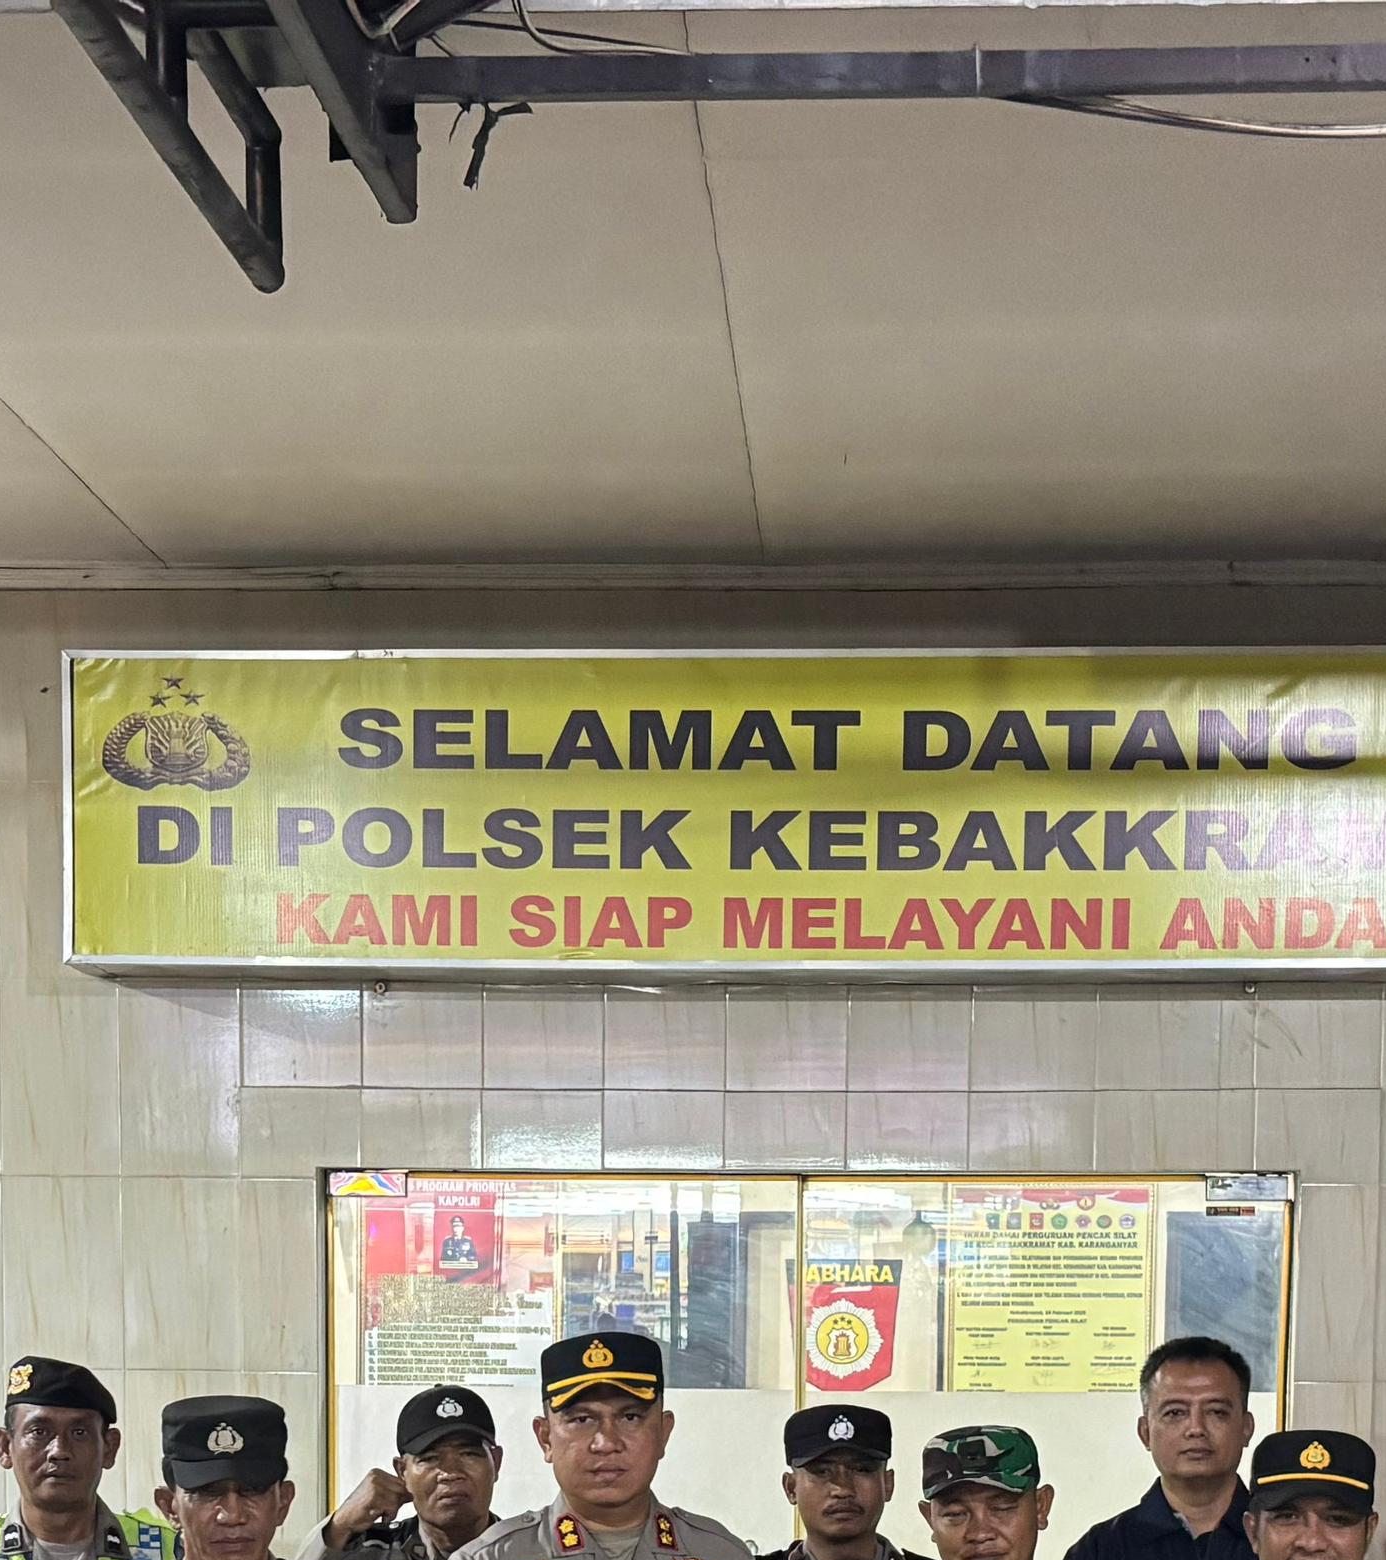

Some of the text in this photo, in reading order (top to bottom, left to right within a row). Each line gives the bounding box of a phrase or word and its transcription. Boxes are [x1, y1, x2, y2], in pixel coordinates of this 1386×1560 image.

[337, 707, 1361, 772] SELAMAT DATANG
[137, 806, 235, 868] DI
[275, 806, 695, 871] POLSEK
[276, 894, 478, 946] KAMI
[510, 895, 693, 948] SIAP
[723, 897, 1131, 950] MELAYANI
[416, 1181, 517, 1192] PROGRAM PRIORITAS
[438, 1195, 481, 1207] KAPOLRI
[1021, 1231, 1074, 1239] PERGURUAN
[1076, 1231, 1111, 1239] PENCAK
[1113, 1231, 1137, 1239] SILAT
[1077, 1241, 1138, 1249] KARANGANYAR
